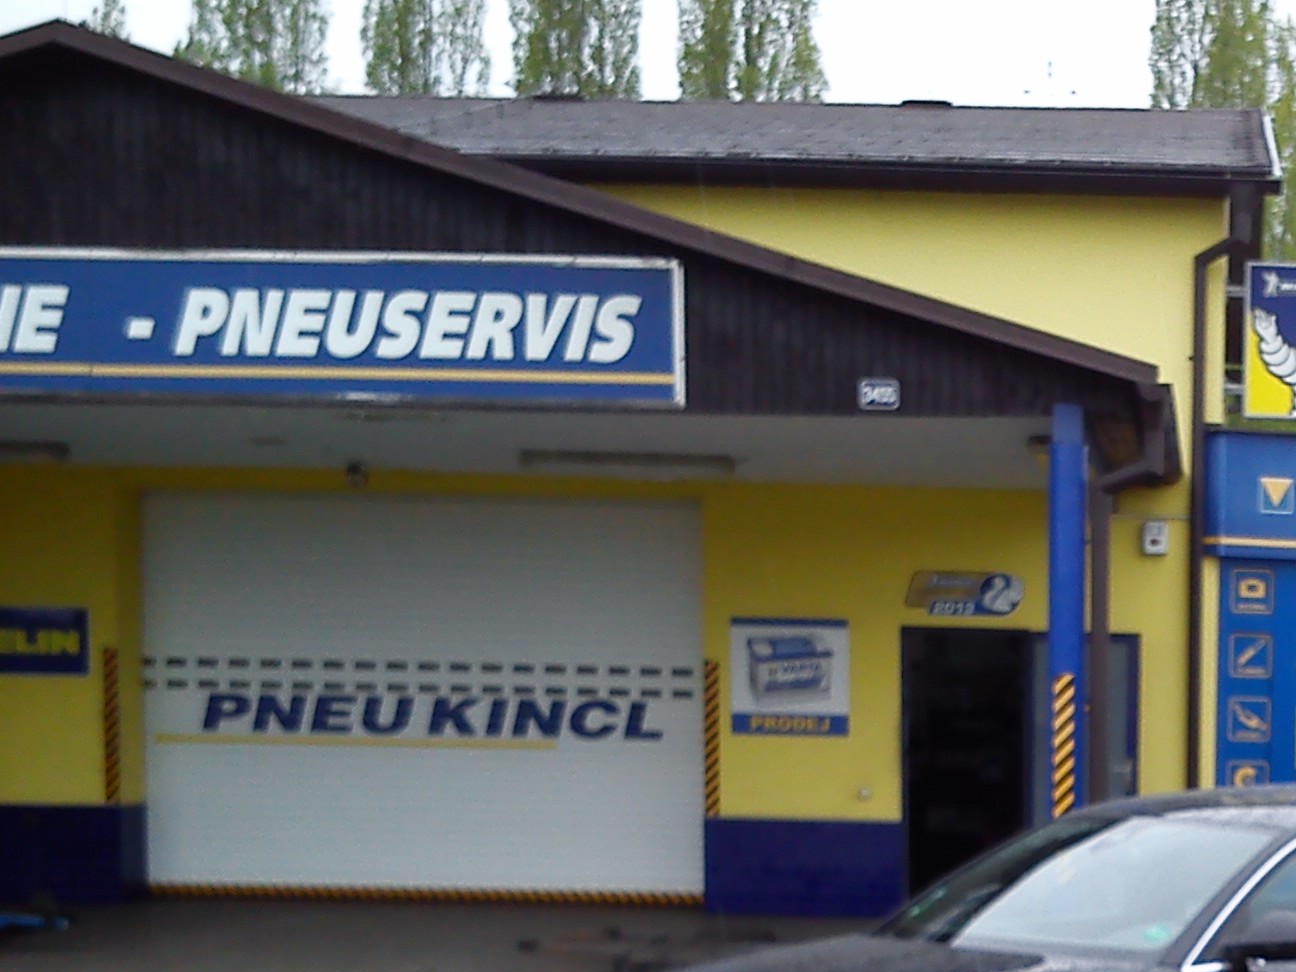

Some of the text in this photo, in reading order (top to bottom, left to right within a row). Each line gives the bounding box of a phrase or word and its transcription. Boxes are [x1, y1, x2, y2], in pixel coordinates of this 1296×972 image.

[173, 286, 643, 364] PNEUSERVIS
[203, 694, 664, 741] PNEU KINCL
[750, 716, 831, 731] PRODEJ
